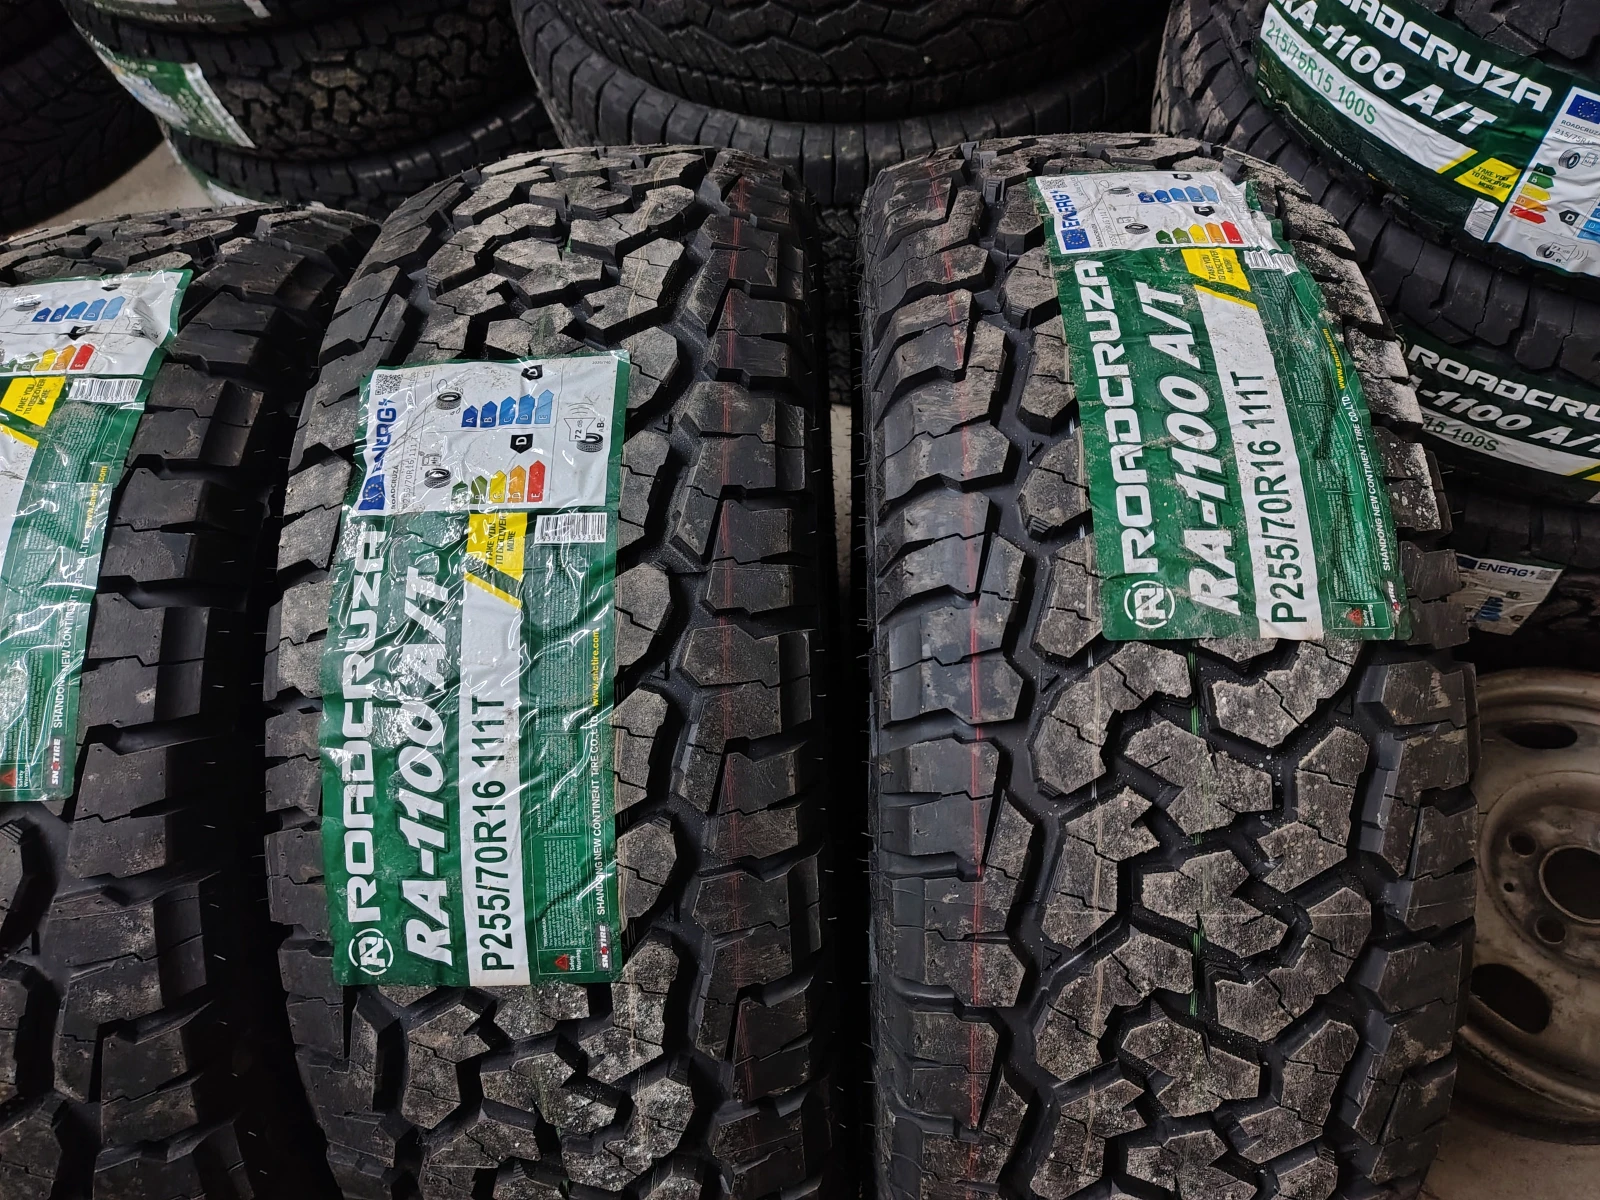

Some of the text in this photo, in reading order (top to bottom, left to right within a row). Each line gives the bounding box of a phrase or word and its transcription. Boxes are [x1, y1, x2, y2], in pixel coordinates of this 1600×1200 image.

[1338, 0, 1552, 112] ADCRUZA
[1337, 84, 1378, 126] 100S
[1400, 83, 1499, 135] A/T
[1052, 192, 1081, 230] ENERG
[1564, 213, 1576, 222] D
[1203, 252, 1216, 281] TAKE YOU
[14, 383, 35, 413] TAKE YOU
[1074, 260, 1159, 574] ROADCRUZA
[515, 436, 527, 447] D
[574, 428, 582, 440] 72
[1352, 423, 1364, 442] TIRE
[1450, 427, 1500, 451] 100S
[1135, 281, 1242, 617] RA-1100 A/T
[1357, 444, 1377, 495] CONTINENT
[85, 465, 108, 529] www.snctir.com
[1230, 371, 1308, 624] P255/70R16 111T
[1370, 495, 1381, 516] NEW
[485, 535, 497, 563] TAKE
[507, 530, 516, 553] MORE
[1374, 517, 1391, 572] SHANDONG
[496, 553, 504, 566] TO
[1477, 562, 1528, 577] ENERG
[342, 530, 387, 923] ROADCRUZA
[397, 565, 453, 967] RA-1100 A/T
[590, 755, 600, 778] TIRE
[591, 779, 602, 837] CONTINENT
[468, 695, 515, 971] P255/70R16 111T
[593, 837, 602, 860] NEW
[568, 955, 577, 972] Safety
[574, 949, 583, 972] Warning
